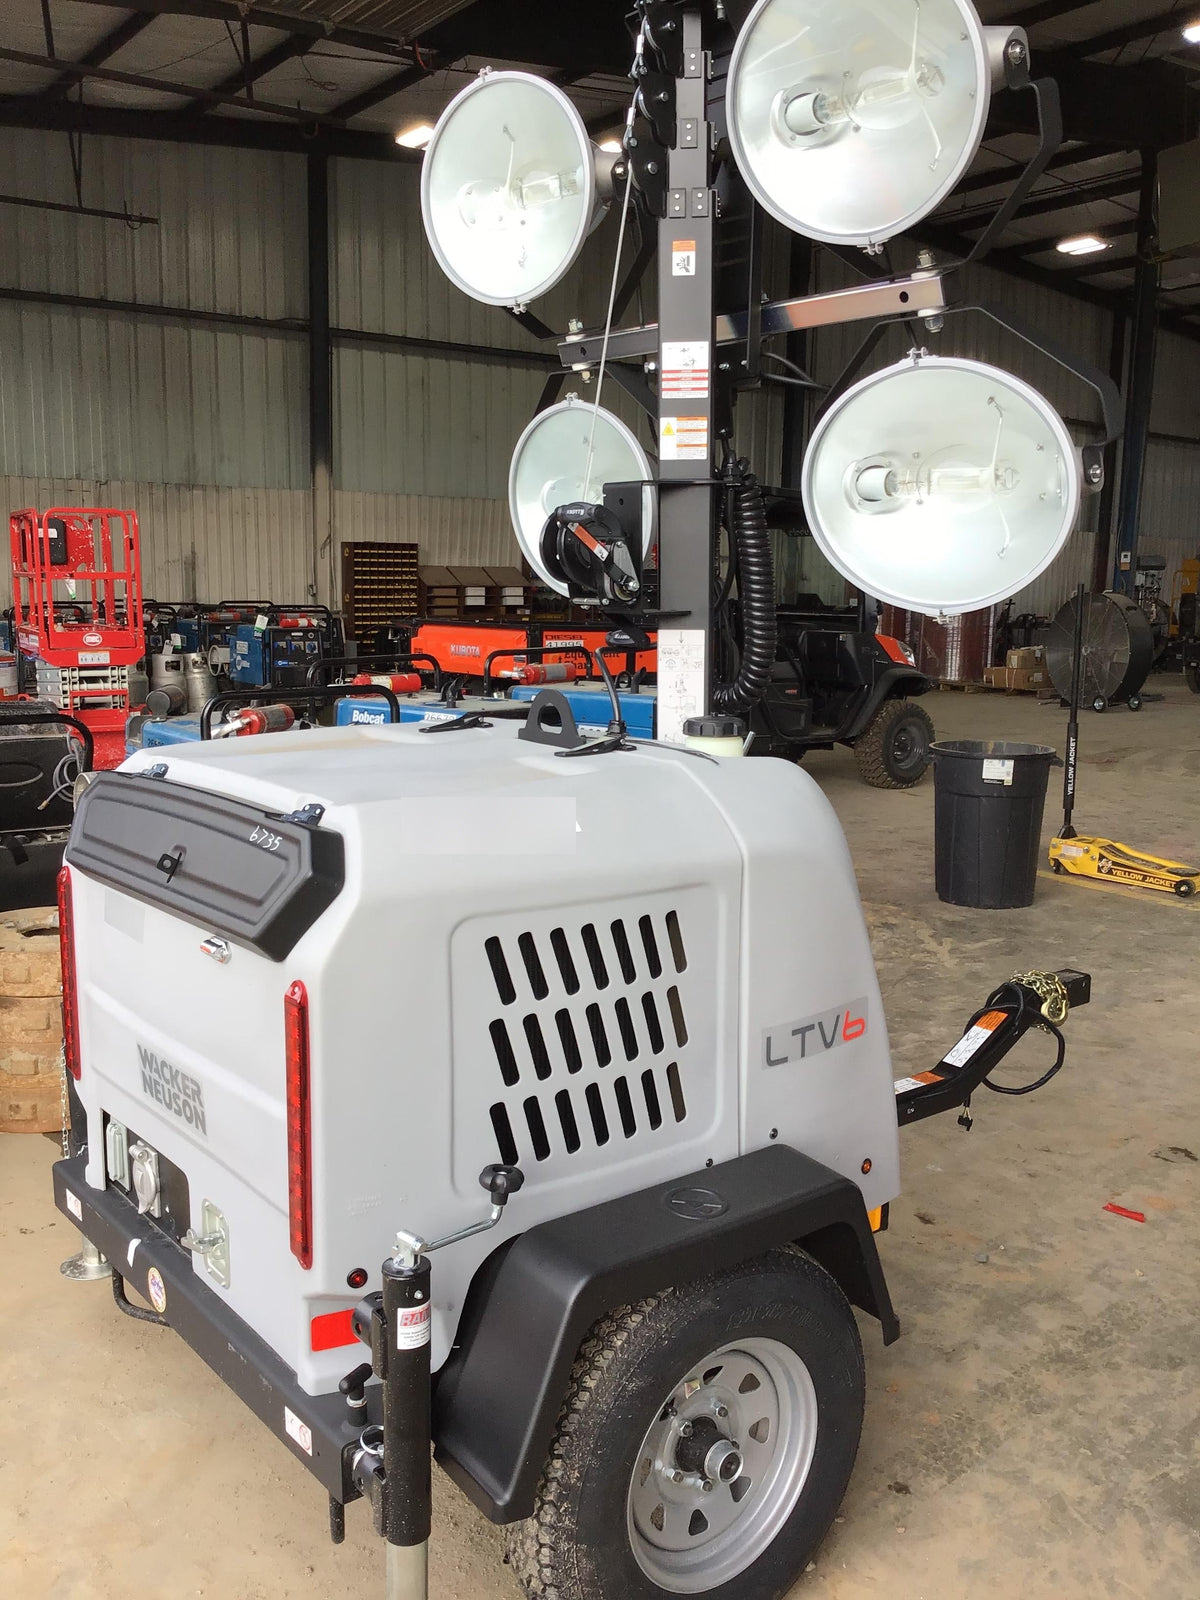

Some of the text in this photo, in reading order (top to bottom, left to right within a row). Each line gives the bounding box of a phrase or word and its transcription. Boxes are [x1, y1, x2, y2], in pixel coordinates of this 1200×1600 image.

[450, 643, 481, 657] KUBOTA
[352, 710, 385, 725] Bobcat
[1066, 737, 1077, 796] YELLOW JACKET
[249, 825, 283, 851] 6735
[1111, 868, 1177, 888] YELLOW JACKET
[766, 1010, 865, 1067] LTV6
[137, 1043, 204, 1109] WACKER
[141, 1070, 207, 1136] NEUSON
